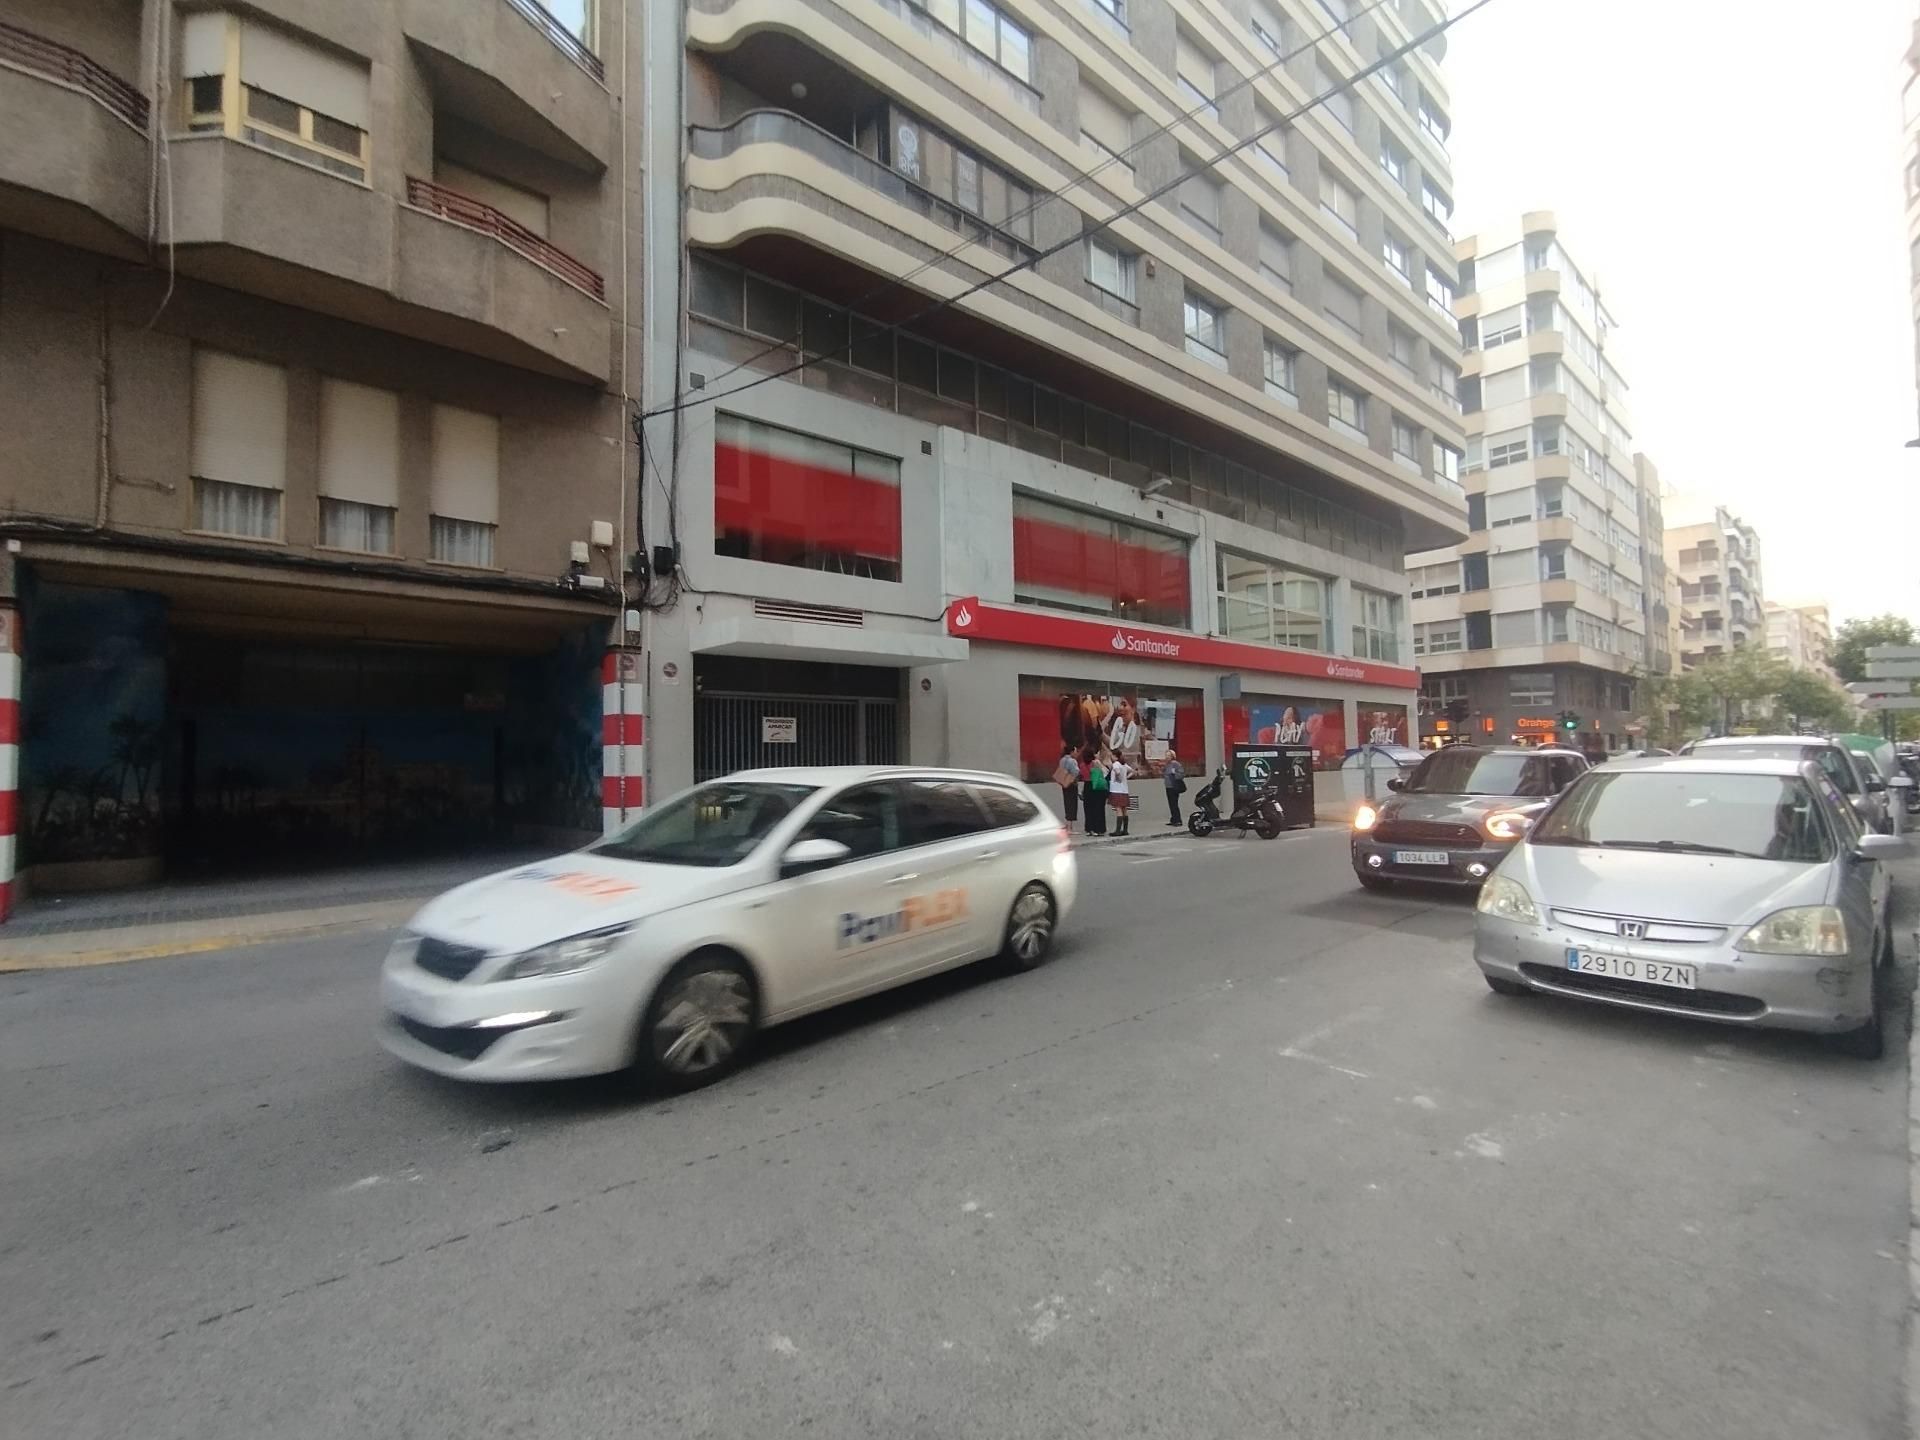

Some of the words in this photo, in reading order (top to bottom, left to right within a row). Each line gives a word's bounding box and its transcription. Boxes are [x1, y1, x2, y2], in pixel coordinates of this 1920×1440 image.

[1127, 635, 1180, 656] Santander
[1335, 664, 1365, 679] Santander
[1274, 721, 1306, 744] PLAY
[1518, 717, 1556, 729] Orange
[1109, 716, 1137, 751] GO
[1369, 726, 1398, 745] START
[1400, 852, 1424, 862] 1034
[1425, 853, 1446, 863] LLR
[1582, 954, 1636, 977] 2910
[1646, 963, 1690, 985] BZN
